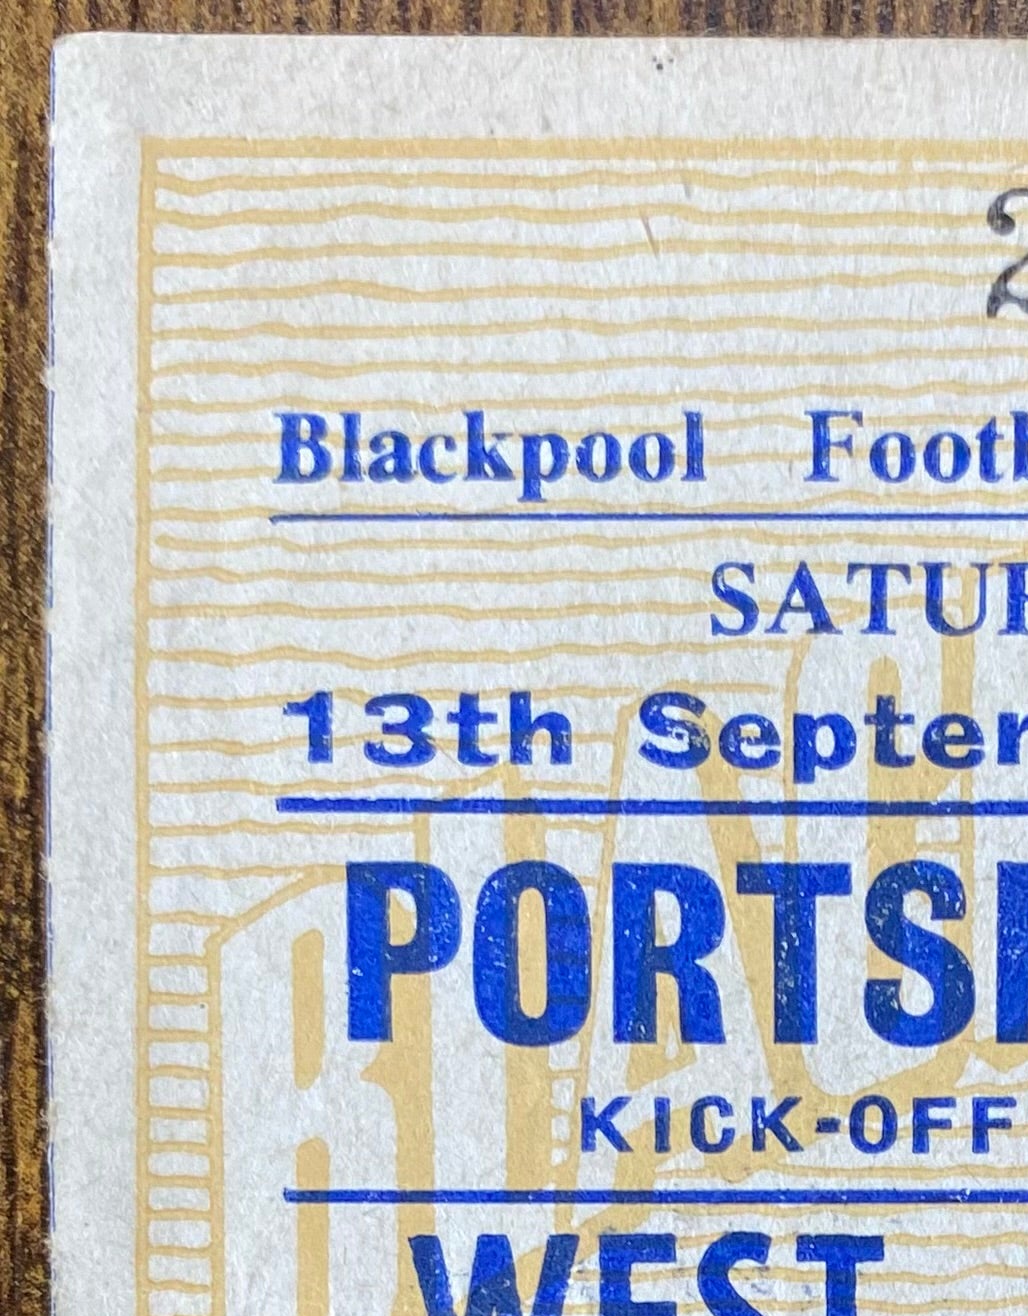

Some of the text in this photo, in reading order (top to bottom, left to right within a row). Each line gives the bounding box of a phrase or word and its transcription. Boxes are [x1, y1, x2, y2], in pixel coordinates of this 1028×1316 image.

[276, 410, 706, 503] Blackpool
[282, 690, 572, 768] 13th
[580, 1094, 1018, 1156] KICK-OFF
